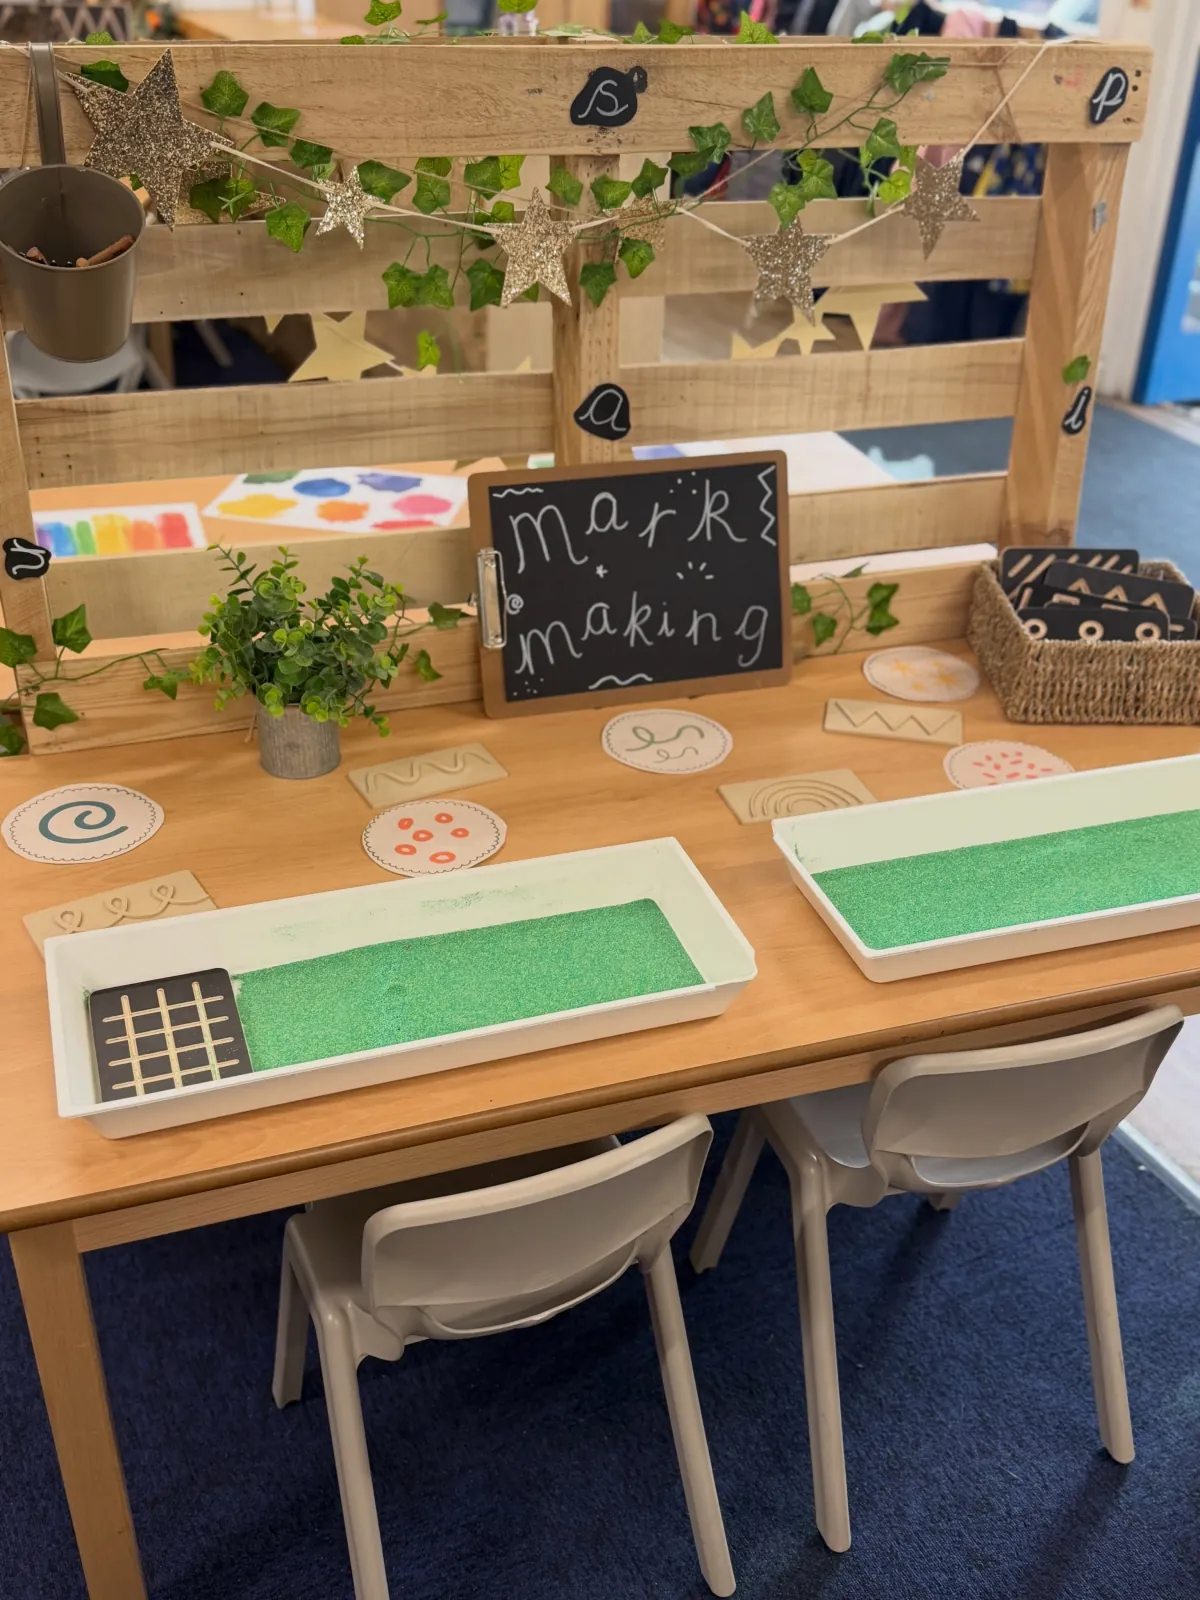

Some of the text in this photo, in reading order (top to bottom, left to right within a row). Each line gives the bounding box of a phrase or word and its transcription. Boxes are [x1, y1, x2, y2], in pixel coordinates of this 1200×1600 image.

[577, 79, 629, 119] s
[1092, 72, 1127, 121] p
[578, 388, 627, 431] a
[1064, 389, 1089, 430] i
[509, 479, 748, 574] mark
[515, 591, 769, 675] making
